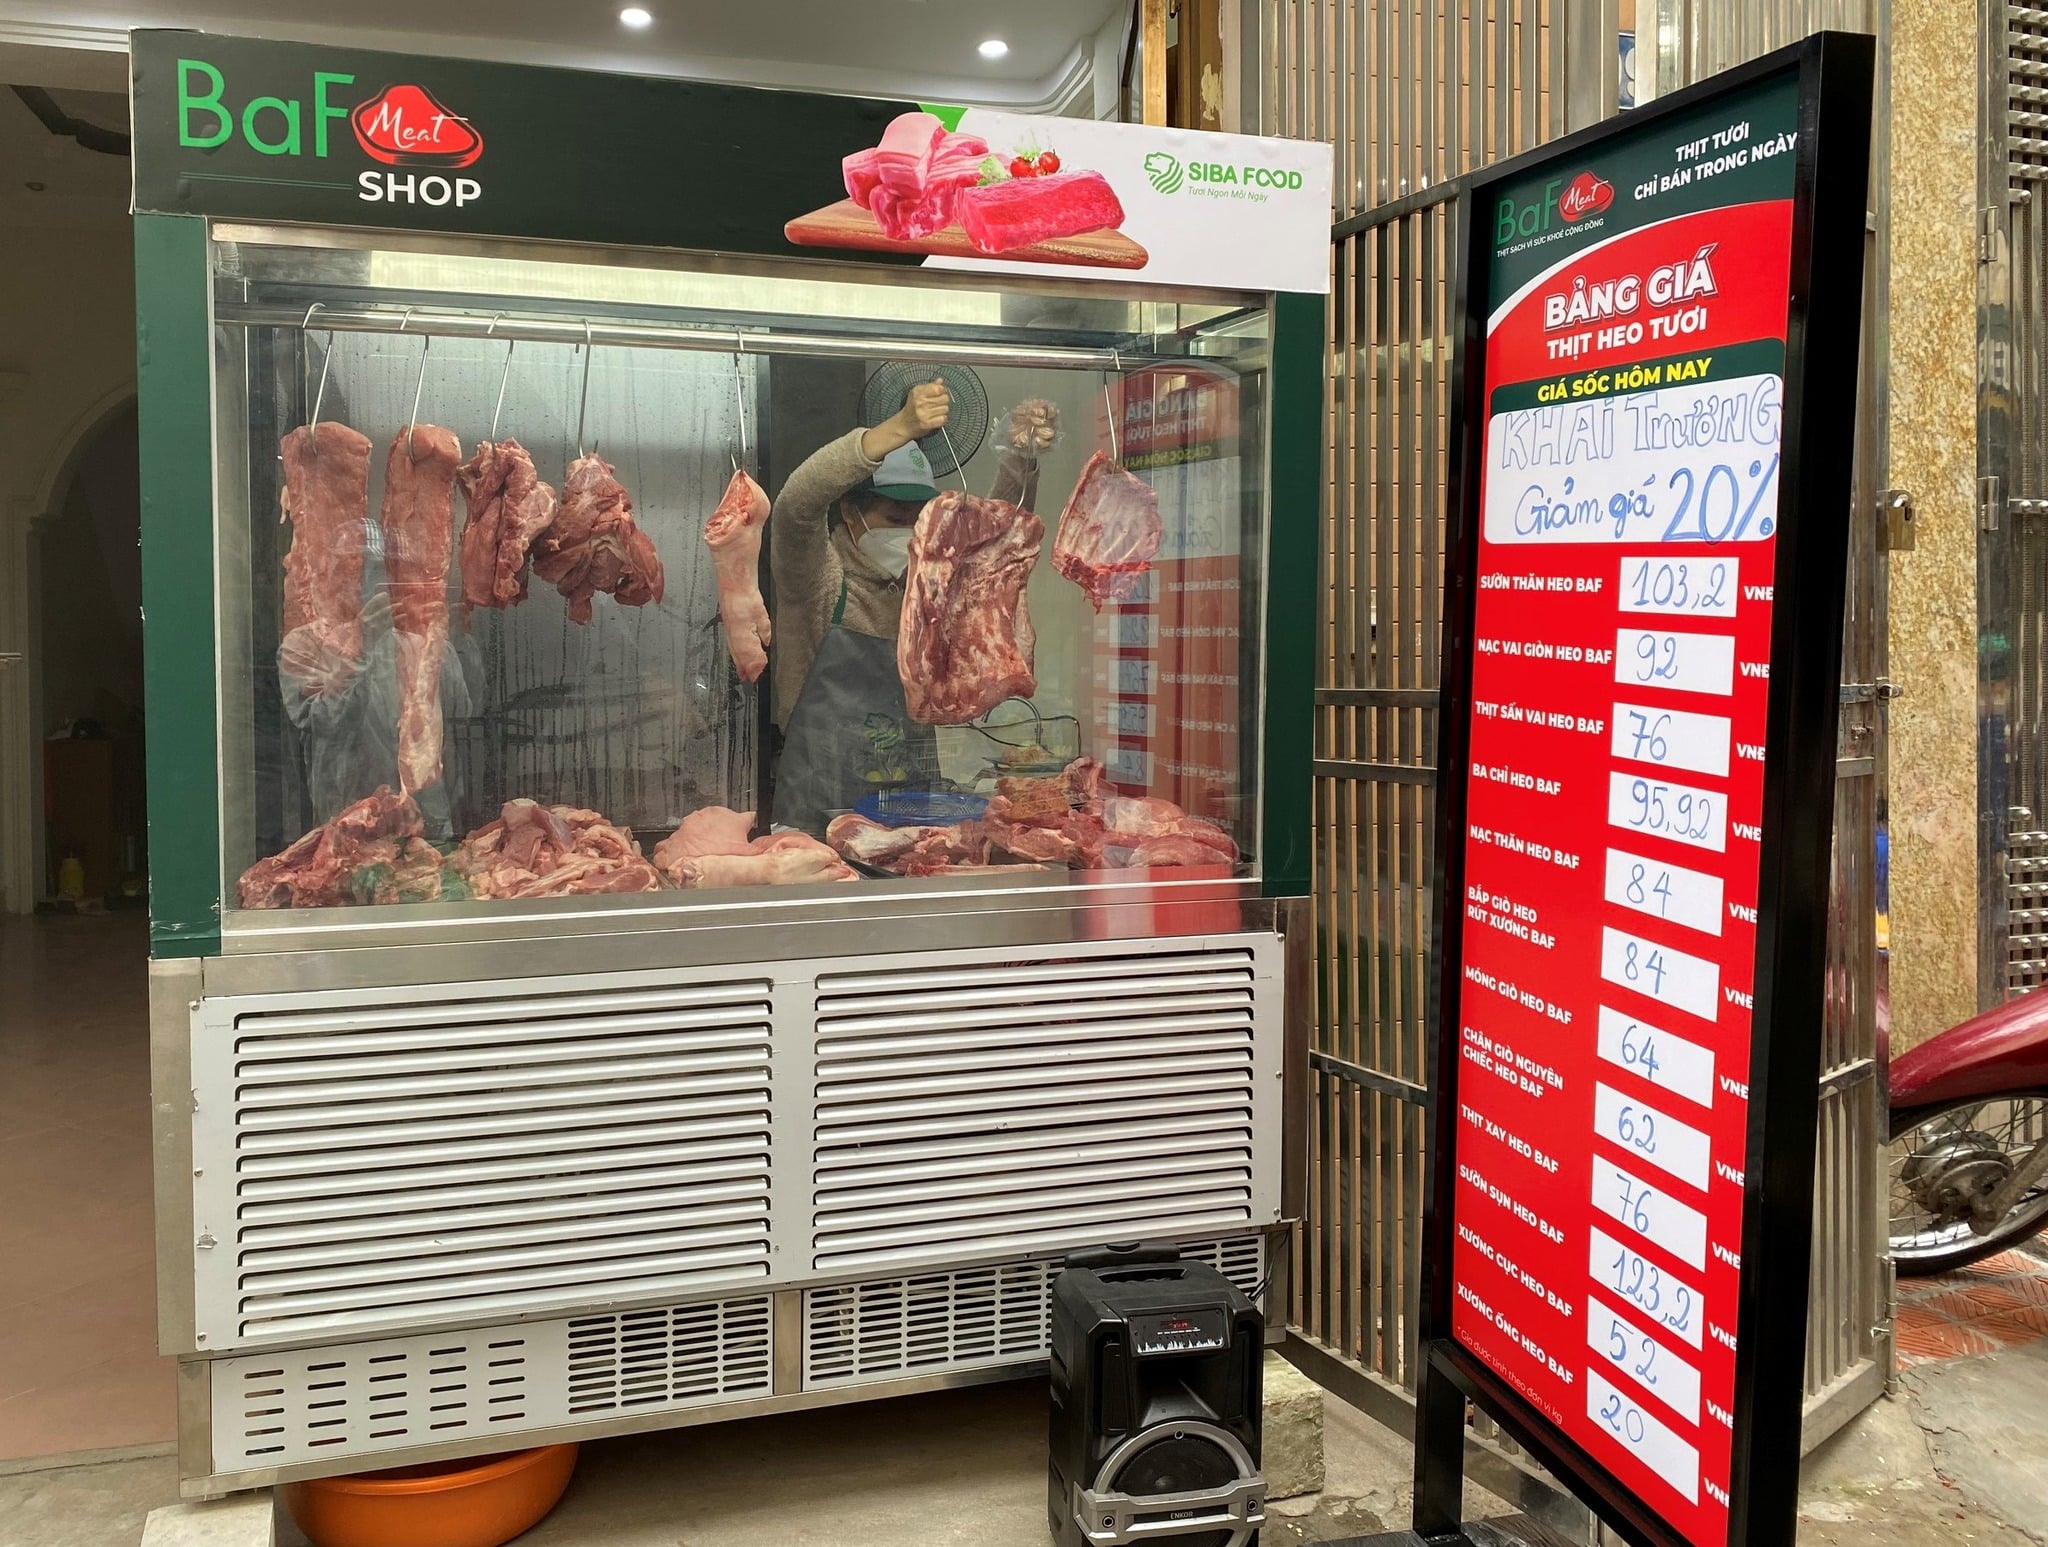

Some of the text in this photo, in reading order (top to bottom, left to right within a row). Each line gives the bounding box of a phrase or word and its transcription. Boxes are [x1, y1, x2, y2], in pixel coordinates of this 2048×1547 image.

[177, 58, 469, 157] BaF Meat
[1676, 121, 1750, 163] THỊT TƯƠI
[358, 170, 482, 208] SHOP
[1188, 162, 1303, 190] SIBA FOOD
[1207, 188, 1229, 198] Ngon
[1634, 132, 1798, 201] CHỈ BÁN TRONG NGÀY
[1497, 178, 1609, 245] BaF Meat
[1545, 243, 1718, 330] BẢNG GIÁ
[1547, 307, 1707, 361] THỊT HEO TƯƠI
[1537, 357, 1712, 402] GIÁ SỐC HÔM NAY
[1514, 452, 1779, 544] Giảm giá 20%
[1480, 572, 1510, 589] SƯỜN
[1513, 572, 1544, 590] THĂN
[1547, 577, 1573, 591] HEO
[1576, 578, 1603, 592] BAF
[1632, 560, 1726, 609] 103,2
[1478, 638, 1500, 656] NẠC
[1502, 641, 1521, 655] VAI
[1524, 640, 1553, 658] GIÒN
[1556, 646, 1582, 662] HEO
[1585, 648, 1612, 664] BAF
[1636, 633, 1678, 681] 92
[1475, 701, 1499, 720] THỊT
[1500, 702, 1523, 721] SẤN
[1526, 709, 1545, 725] VAI
[1548, 713, 1575, 729] HEO
[1577, 717, 1604, 735] BAF
[1629, 710, 1672, 761] 76
[1472, 763, 1488, 779] BA
[1489, 765, 1508, 783] CHỈ
[1510, 772, 1534, 789] HEO
[1536, 778, 1561, 795] BAF
[1628, 779, 1711, 840] 95,92
[1468, 883, 1537, 923] BẮP GIÒ HEO
[1470, 824, 1492, 844] NẠC
[1494, 832, 1524, 853] THĂN
[1526, 842, 1551, 861] HEO
[1554, 850, 1580, 869] BAF
[1626, 863, 1672, 917] 84
[1468, 904, 1488, 923] RÚT
[1489, 912, 1529, 940] XƯƠNG
[1531, 929, 1556, 949] BAF
[1624, 941, 1667, 994] 84
[1465, 965, 1496, 991] MÓNG
[1498, 981, 1518, 1000] GIÒ
[1520, 991, 1545, 1013] HEO
[1547, 1003, 1572, 1025] BAF
[1621, 1024, 1660, 1081] 64
[1463, 1026, 1563, 1090] CHÂN GIÒ NGUYÊN
[1463, 1044, 1493, 1071] CHIẾC
[1495, 1062, 1518, 1085] HEO
[1520, 1076, 1544, 1098] BAF
[1618, 1106, 1656, 1154] 62
[1461, 1104, 1484, 1128] THỊT
[1485, 1120, 1506, 1143] XAY
[1508, 1134, 1532, 1158] HEO
[1534, 1149, 1559, 1174] BAF
[1616, 1172, 1652, 1234] 76
[1459, 1164, 1488, 1194] SƯỜN
[1489, 1185, 1511, 1210] SỤN
[1513, 1200, 1537, 1227] HEO
[1539, 1218, 1564, 1245] BAF
[1612, 1249, 1691, 1332] 123,2
[1458, 1223, 1494, 1260] XƯƠNG
[1496, 1253, 1518, 1278] CỤC
[1520, 1270, 1545, 1298] HEO
[1547, 1290, 1573, 1317] BAF
[1609, 1319, 1657, 1385] 52
[1457, 1282, 1493, 1321] XƯƠNG
[1495, 1312, 1519, 1343] ỐNG
[1521, 1334, 1545, 1363] HEO
[1548, 1356, 1573, 1385] BAF
[1600, 1393, 1645, 1443] 20
